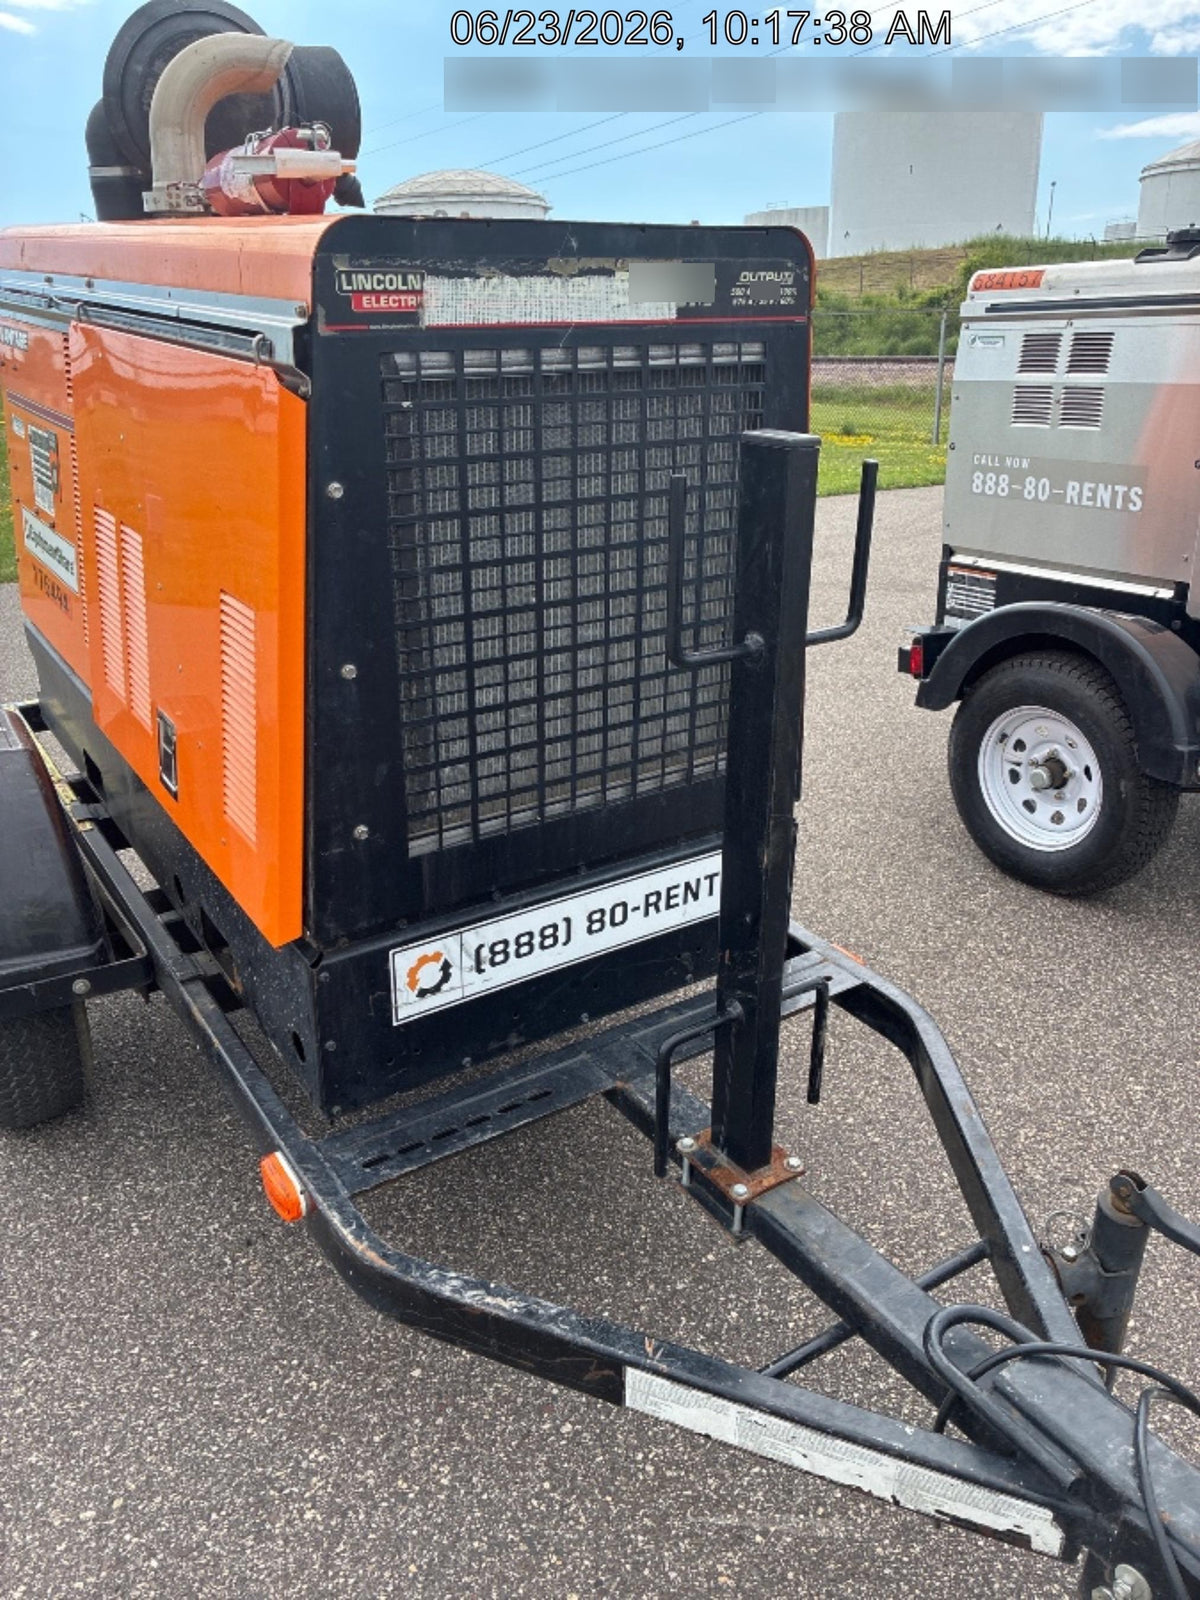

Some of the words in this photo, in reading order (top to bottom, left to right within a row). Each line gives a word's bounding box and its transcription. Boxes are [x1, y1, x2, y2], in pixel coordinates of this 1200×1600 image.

[340, 273, 421, 291] LINCOLN
[361, 295, 420, 308] ELECTR
[973, 453, 1001, 467] CALL
[1005, 456, 1031, 469] NOW
[972, 470, 1144, 512] 888-80-RENTS
[473, 917, 573, 974] (888)
[586, 871, 720, 936] 80-RENT
